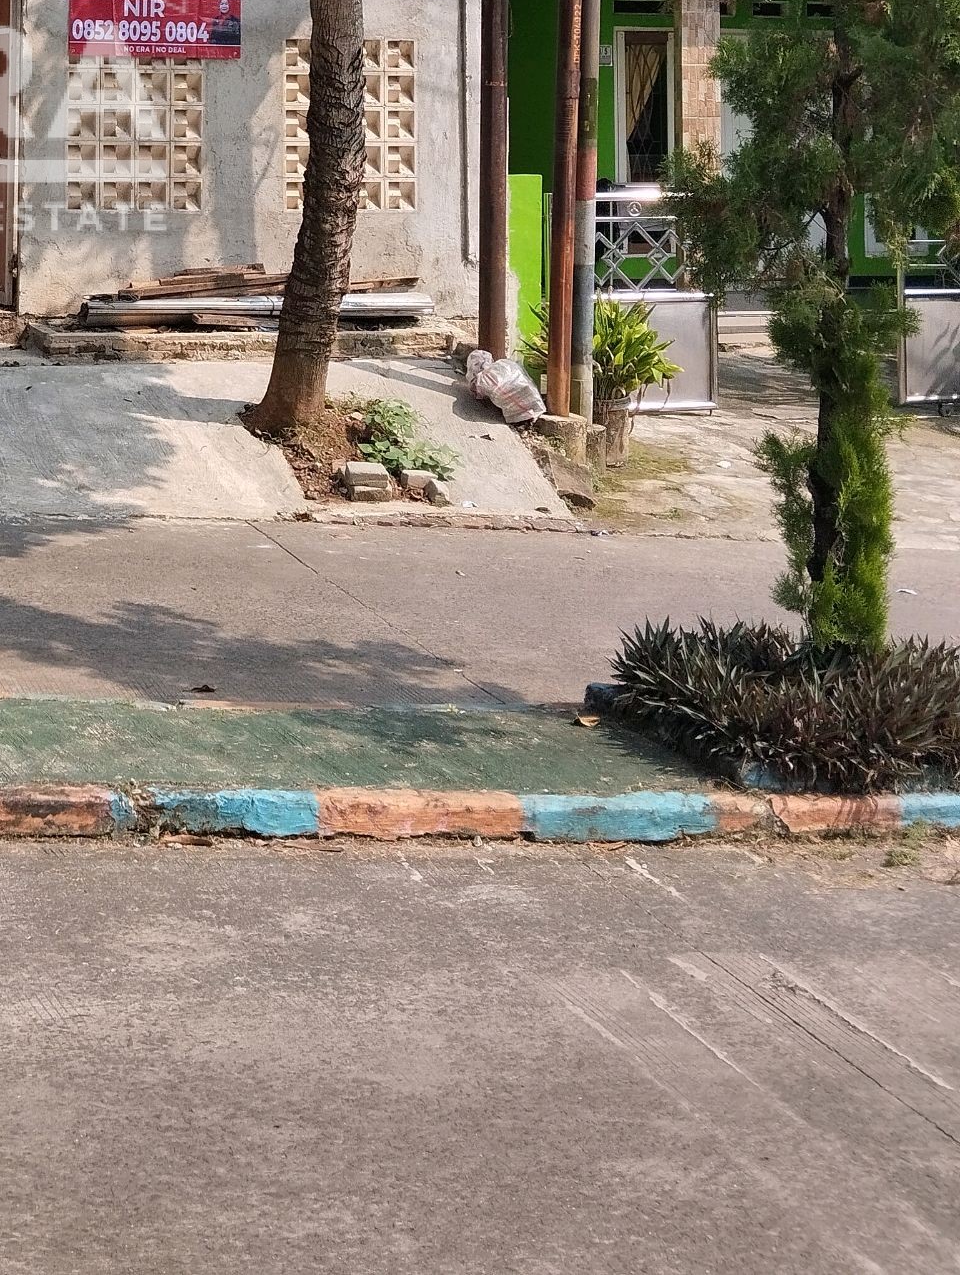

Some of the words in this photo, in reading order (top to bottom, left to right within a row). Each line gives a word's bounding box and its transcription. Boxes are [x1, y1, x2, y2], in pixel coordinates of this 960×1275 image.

[72, 19, 114, 40] 0852
[118, 20, 161, 42] 8095
[165, 21, 209, 43] 0804
[123, 45, 134, 53] NO
[136, 45, 150, 53] ERA
[168, 46, 186, 54] DEAL
